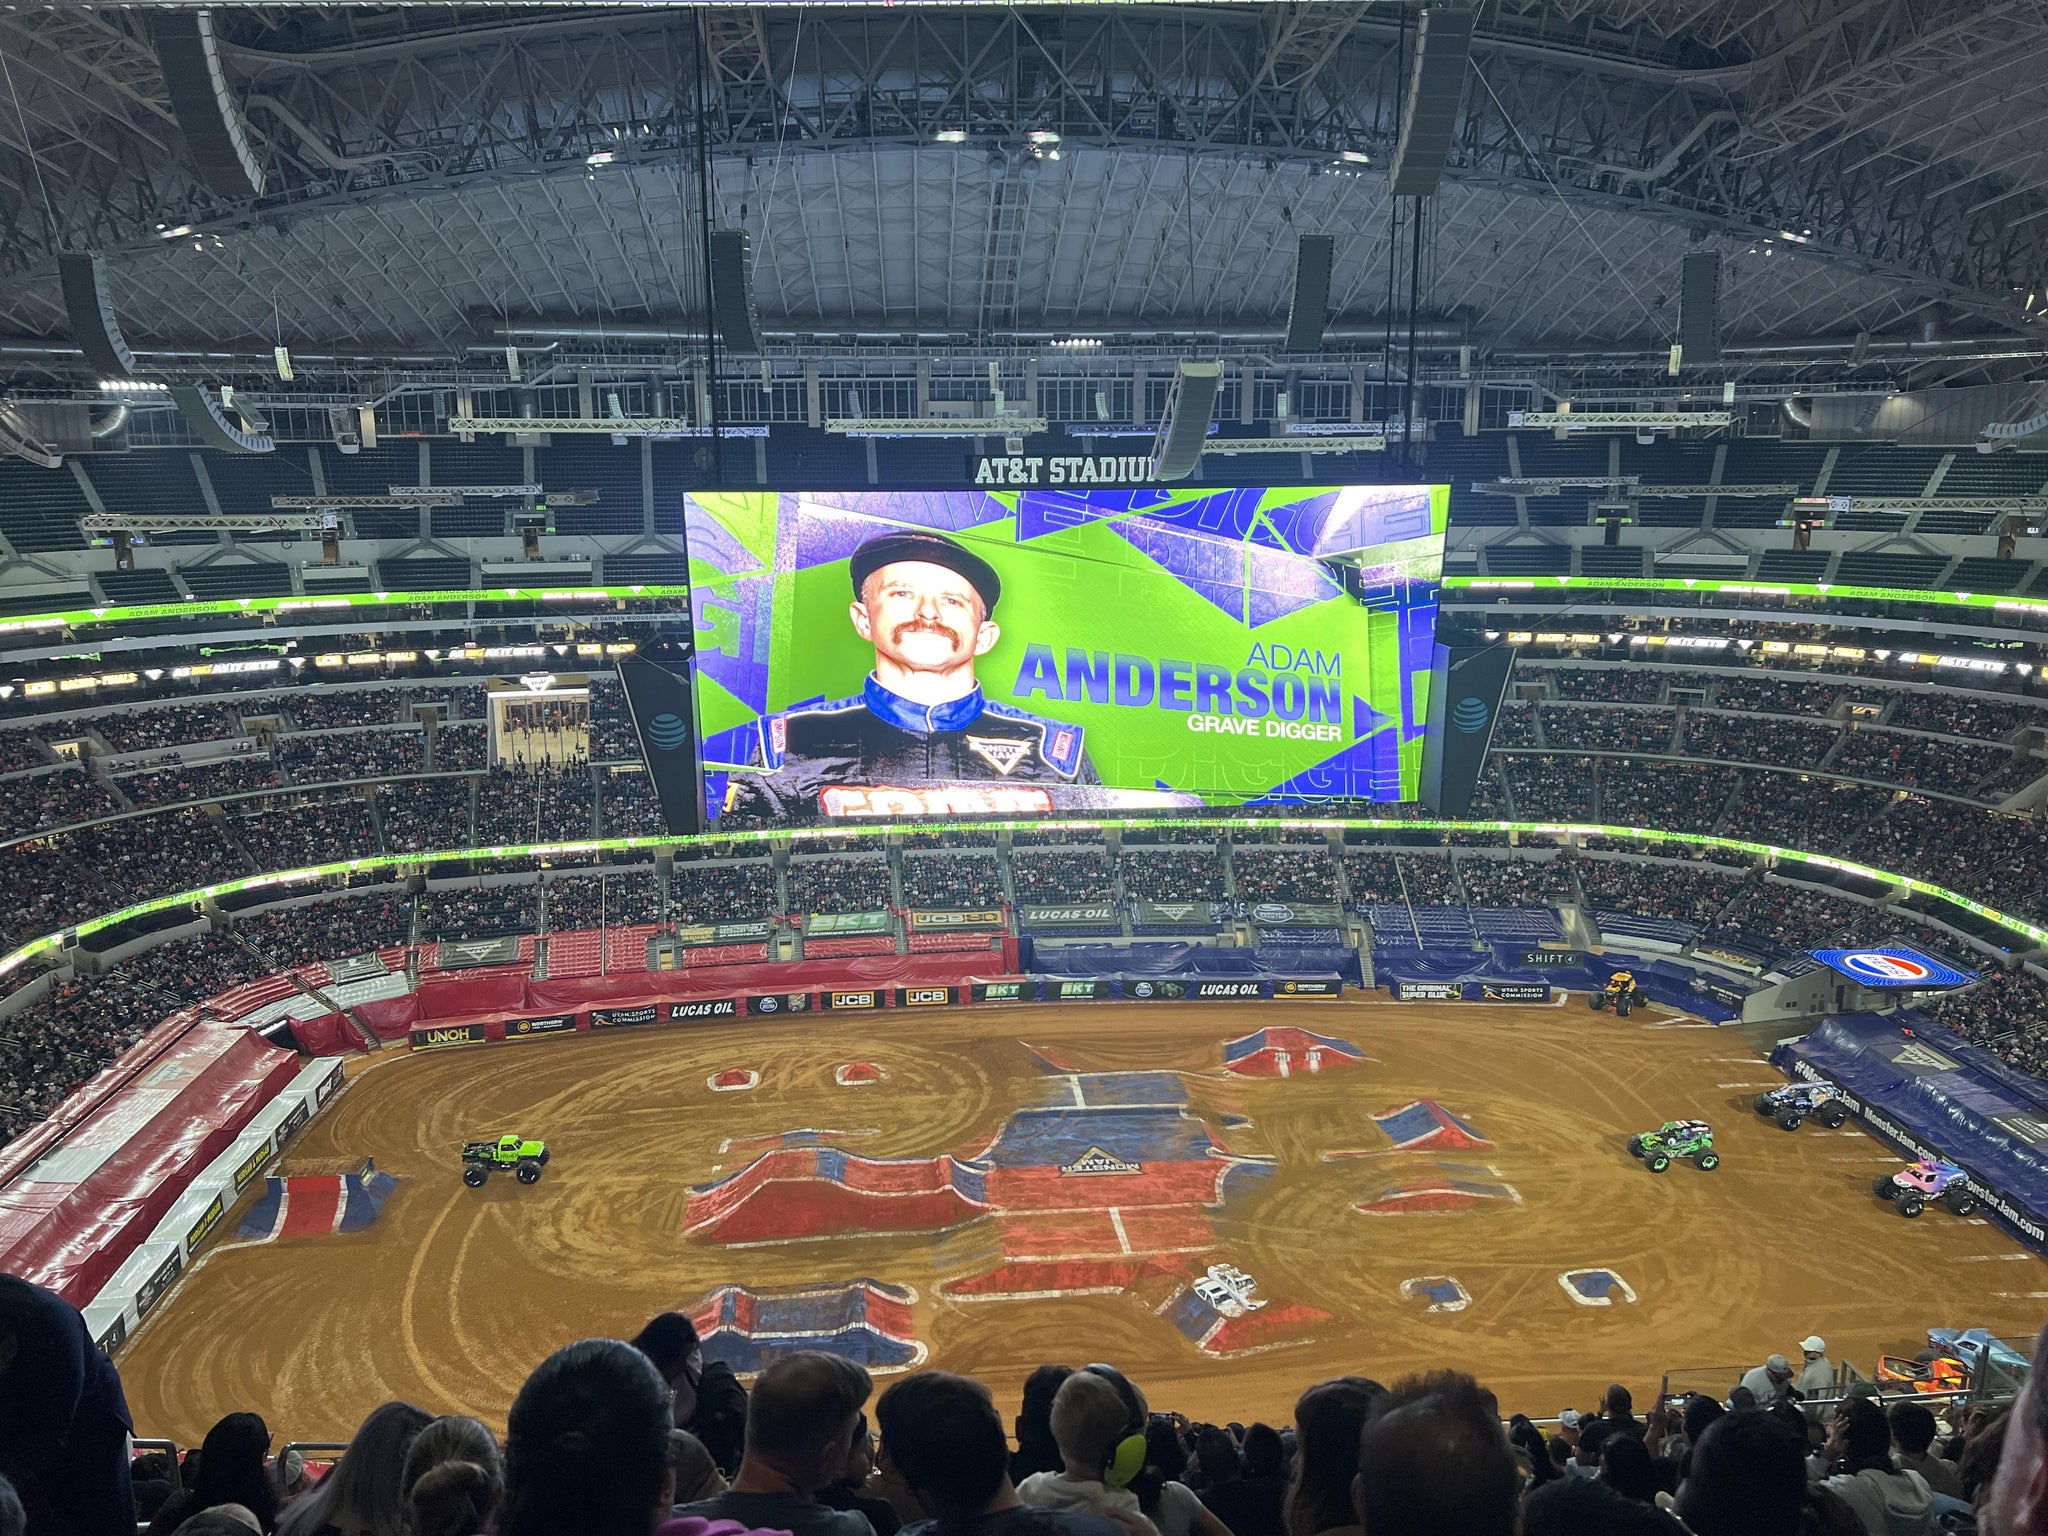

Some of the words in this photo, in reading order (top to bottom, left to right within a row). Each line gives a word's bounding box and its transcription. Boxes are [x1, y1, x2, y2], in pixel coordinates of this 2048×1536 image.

[974, 457, 1043, 483] AT&T
[1050, 457, 1156, 482] STADIU
[1850, 590, 1879, 598] ADAM
[1880, 592, 1936, 601] ANDERSON
[128, 609, 159, 617] ADAM
[161, 605, 218, 615] ANDERSON
[1246, 641, 1341, 677] ADAM
[1012, 642, 1342, 724] ANDERSON
[1187, 714, 1260, 737] GRAVE
[1265, 720, 1342, 742] DIGGER
[812, 913, 885, 928] BKT
[1029, 910, 1081, 920] LUCAS
[1085, 909, 1110, 918] OIL
[1862, 955, 1909, 977] PEPSI
[986, 985, 1019, 996] BKT
[1060, 982, 1094, 995] BKT
[1200, 984, 1238, 995] LUCAS
[1240, 984, 1259, 995] OIL
[835, 995, 871, 1005] JCB
[910, 991, 944, 1002] JCB
[631, 1008, 656, 1016] SPORTS
[672, 1005, 711, 1018] LUCAS
[612, 1014, 656, 1023] COMMISSION
[427, 1027, 470, 1043] UNOH
[1864, 1106, 1937, 1162] MonsterJam.com
[1967, 1180, 2045, 1241] onsterJam.com
